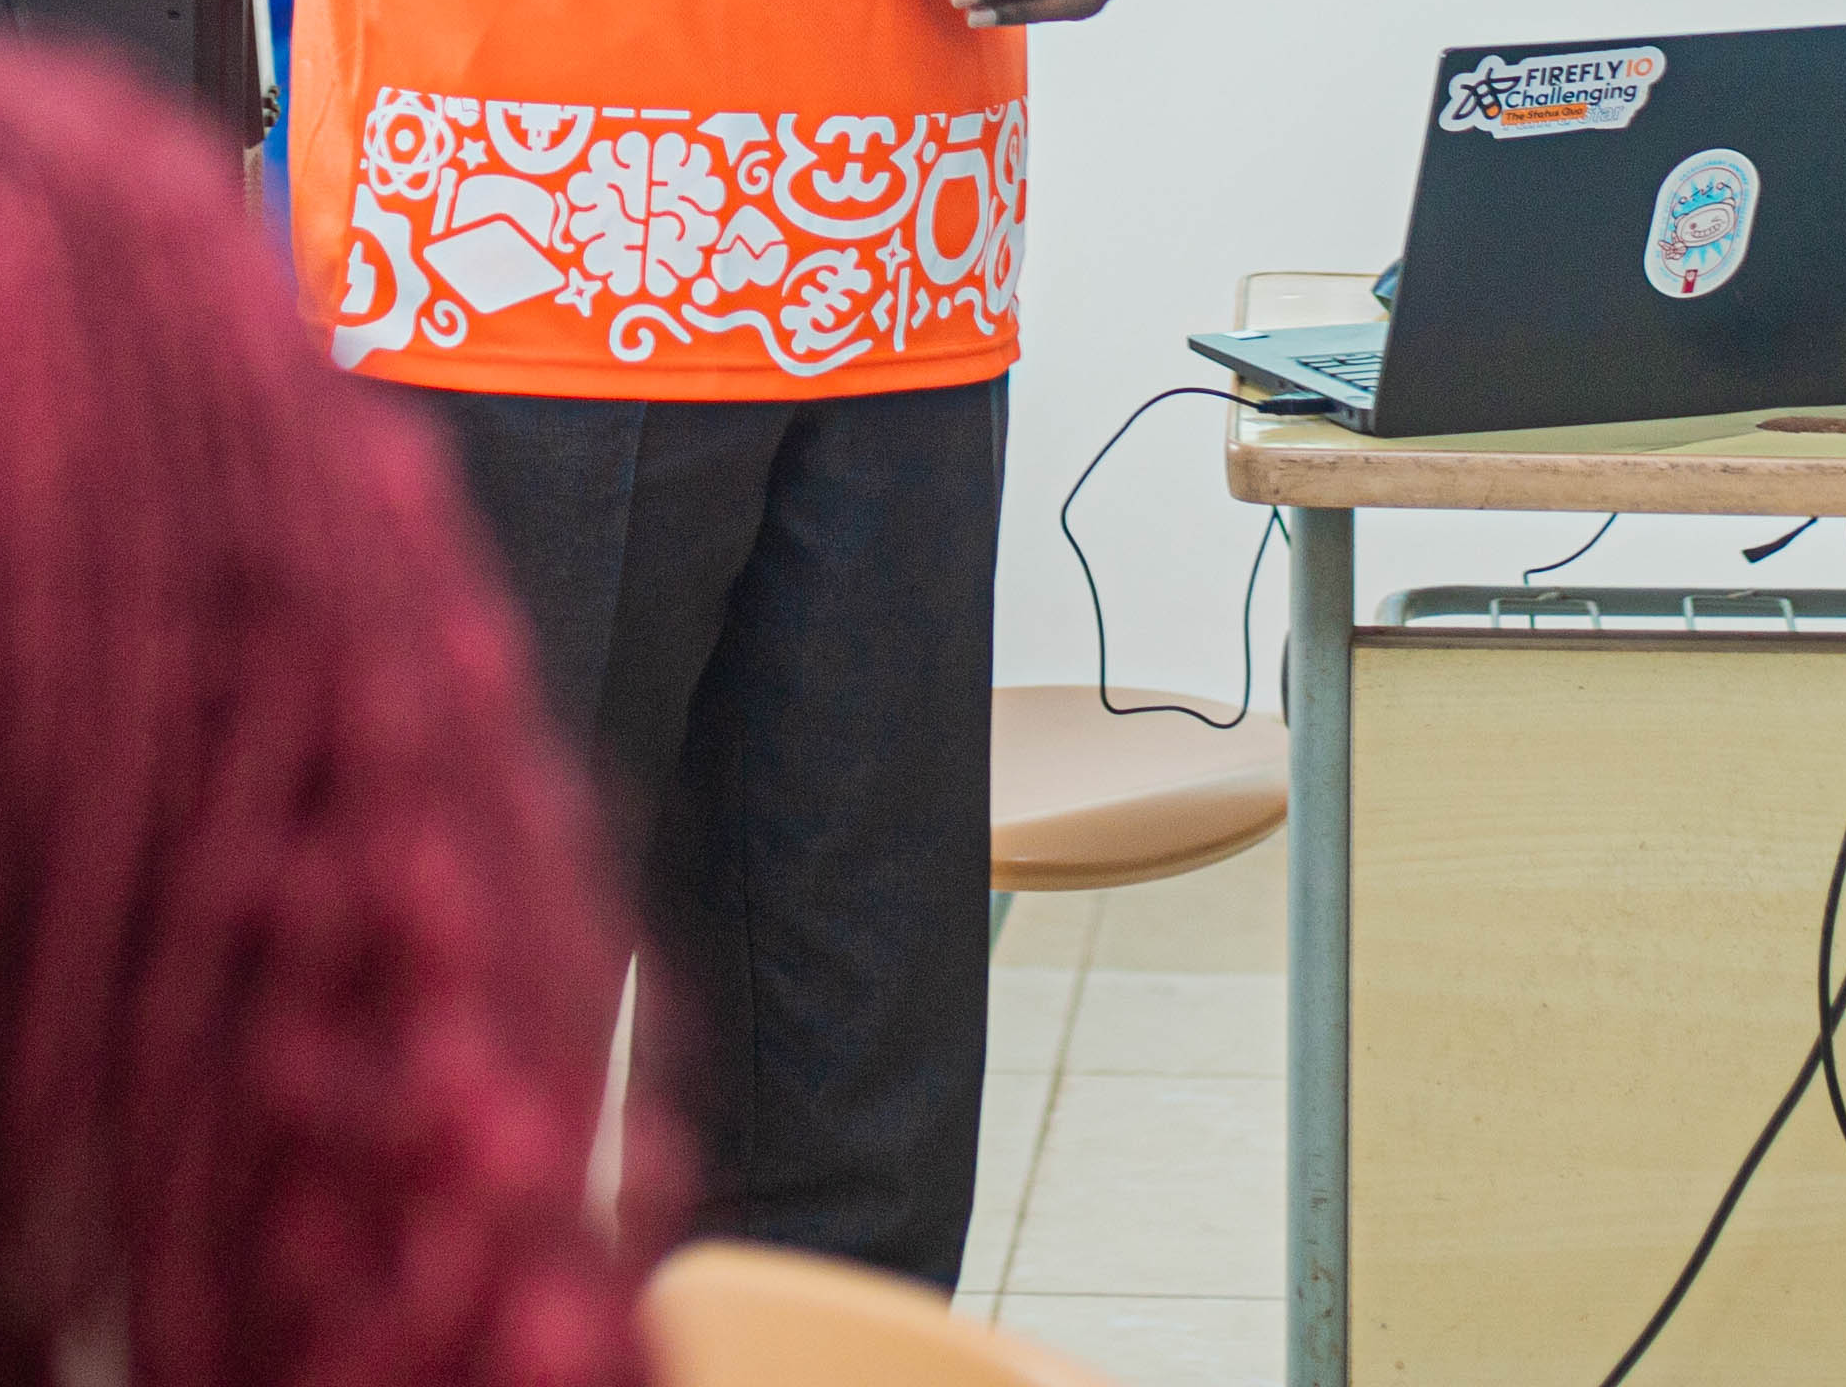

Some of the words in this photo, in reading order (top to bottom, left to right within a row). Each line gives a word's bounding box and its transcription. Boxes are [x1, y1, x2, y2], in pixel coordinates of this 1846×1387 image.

[1525, 59, 1623, 87] FIREFLY
[1504, 82, 1638, 109] Challenging
[1505, 111, 1526, 121] The
[1527, 109, 1559, 120] Status
